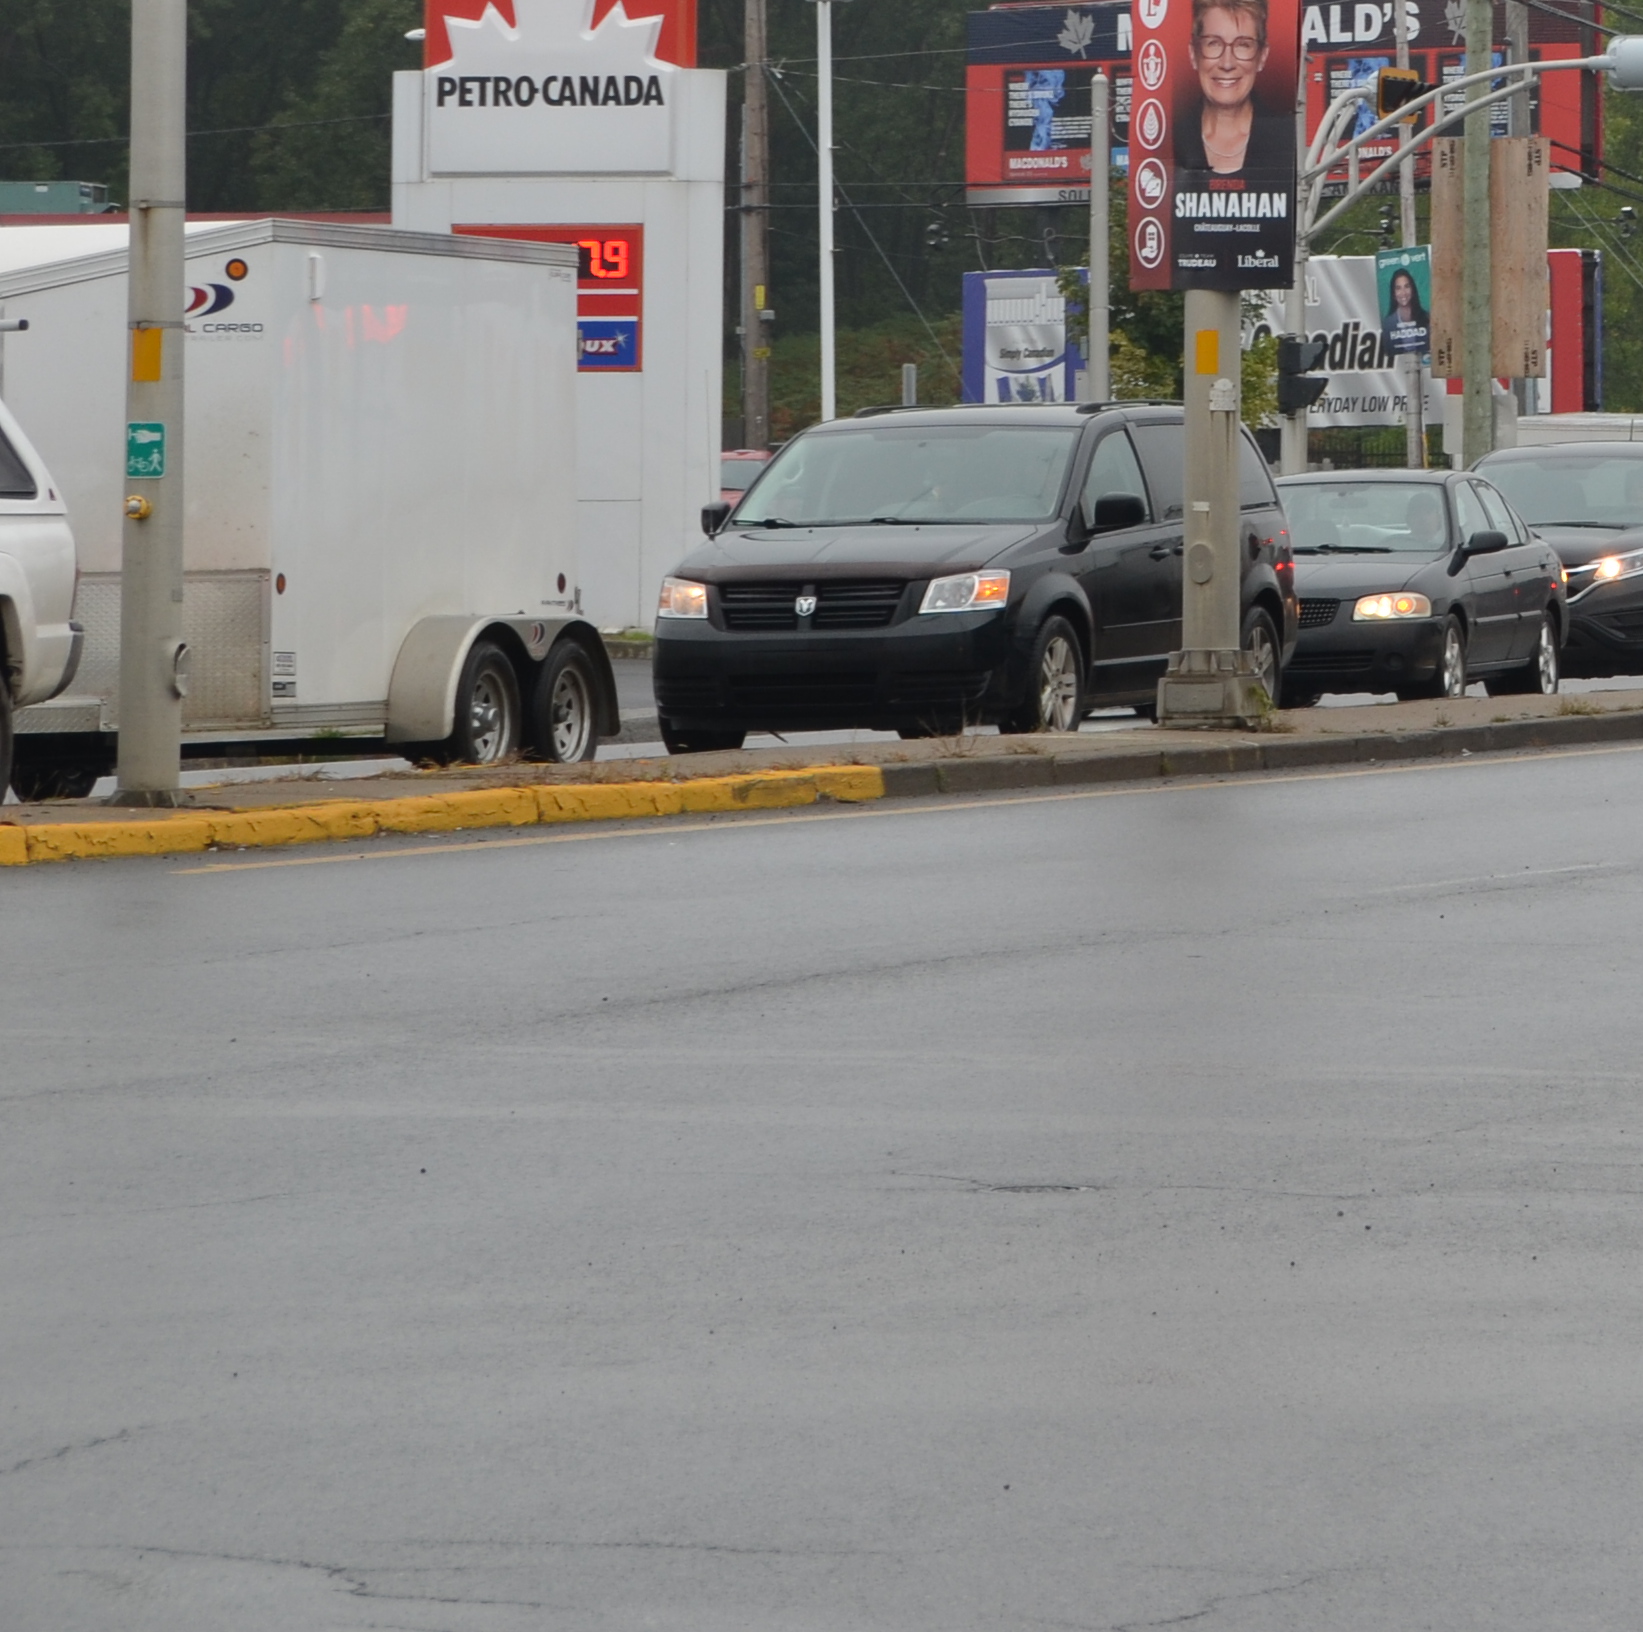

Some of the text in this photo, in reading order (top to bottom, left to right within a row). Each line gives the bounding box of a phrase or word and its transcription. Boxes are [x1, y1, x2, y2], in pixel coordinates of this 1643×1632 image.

[1175, 192, 1288, 218] SHANAHAN
[1177, 253, 1279, 268] TRUDEAU Liberal
[203, 322, 264, 334] CARGO
[1390, 327, 1427, 340] HADDAD
[1361, 396, 1389, 413] LOW
